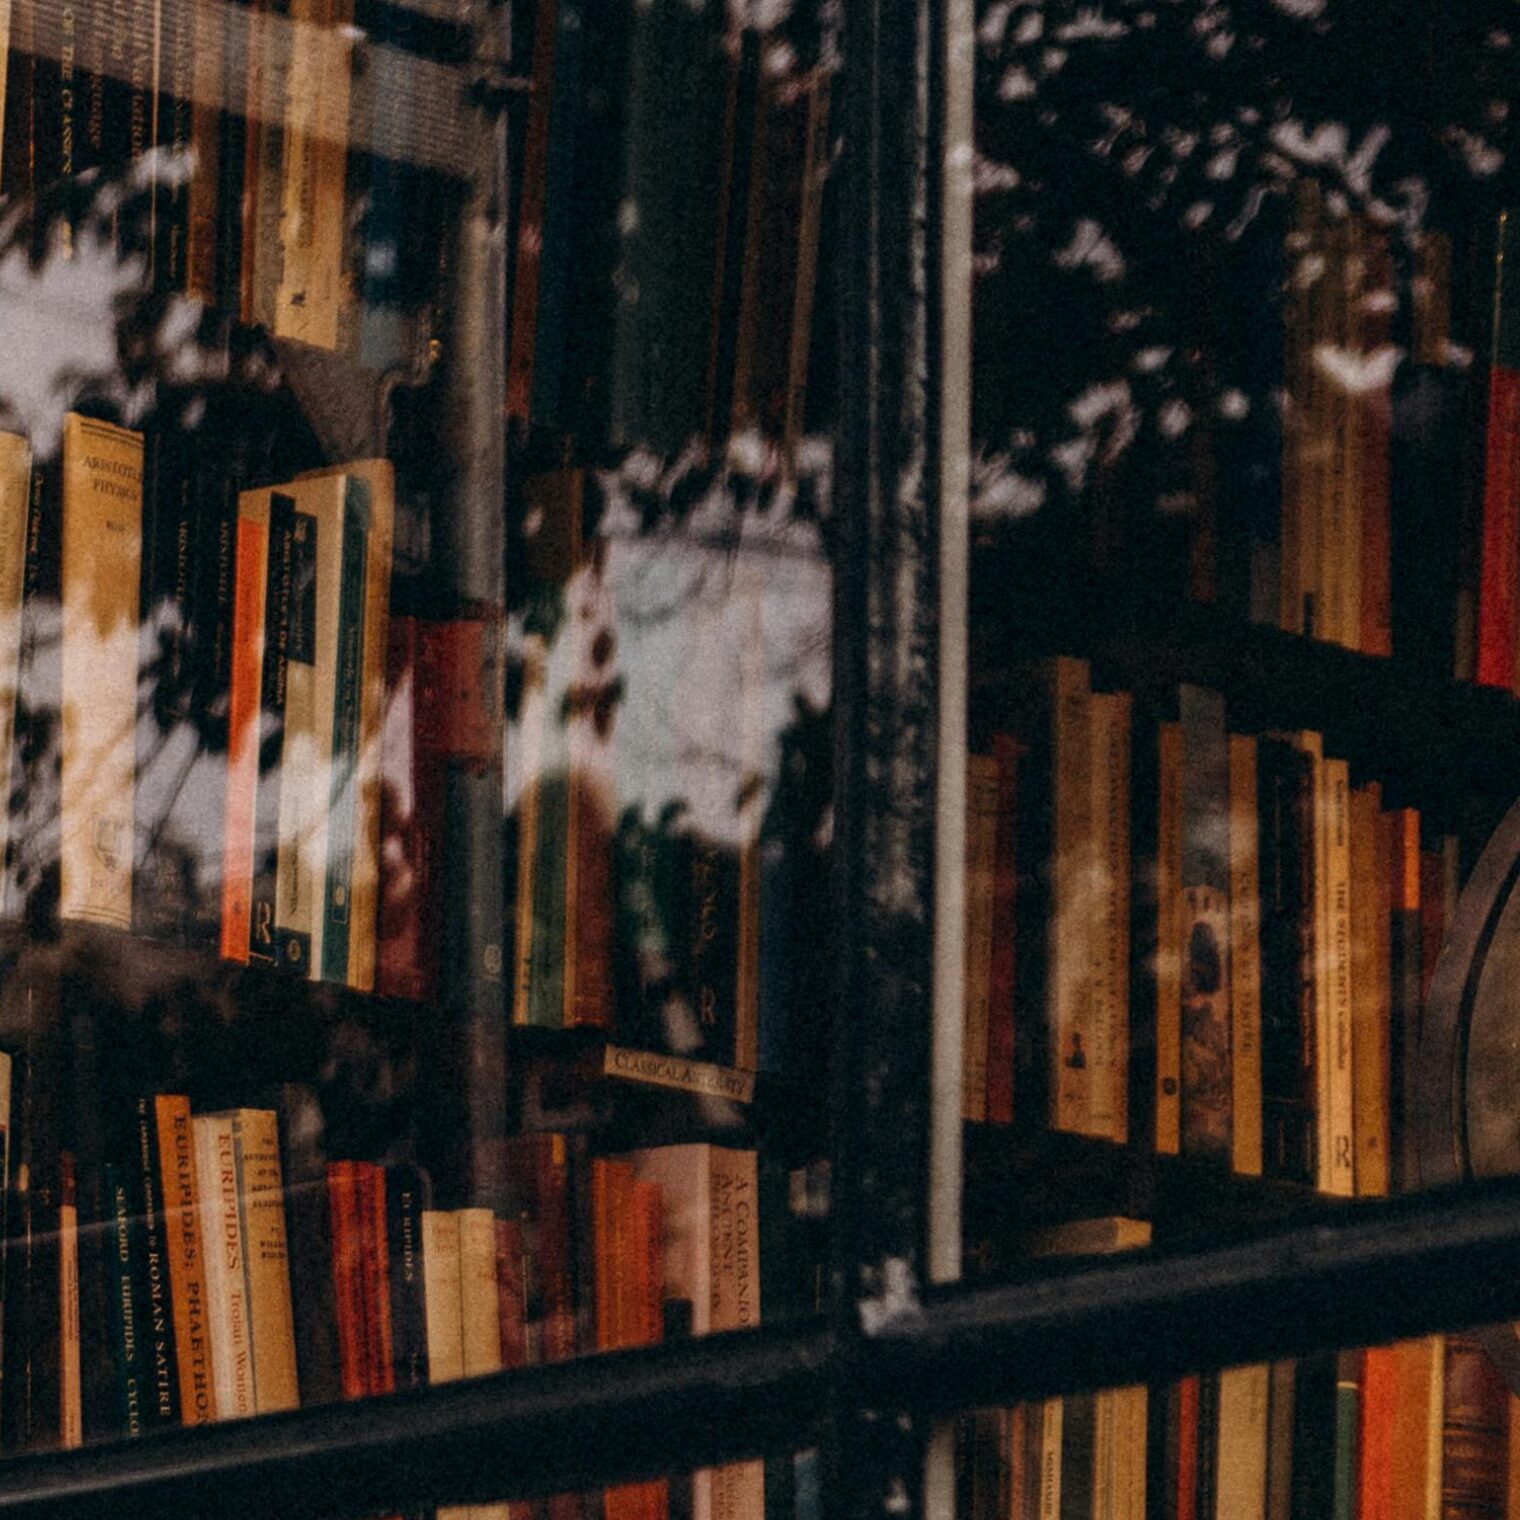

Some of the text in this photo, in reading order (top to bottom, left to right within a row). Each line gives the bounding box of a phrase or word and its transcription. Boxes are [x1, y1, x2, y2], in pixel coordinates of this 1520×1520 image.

[172, 1111, 198, 1269] EURIPIDES:
[216, 1132, 240, 1271] EURIPIDES
[146, 1251, 165, 1332] ROMAN
